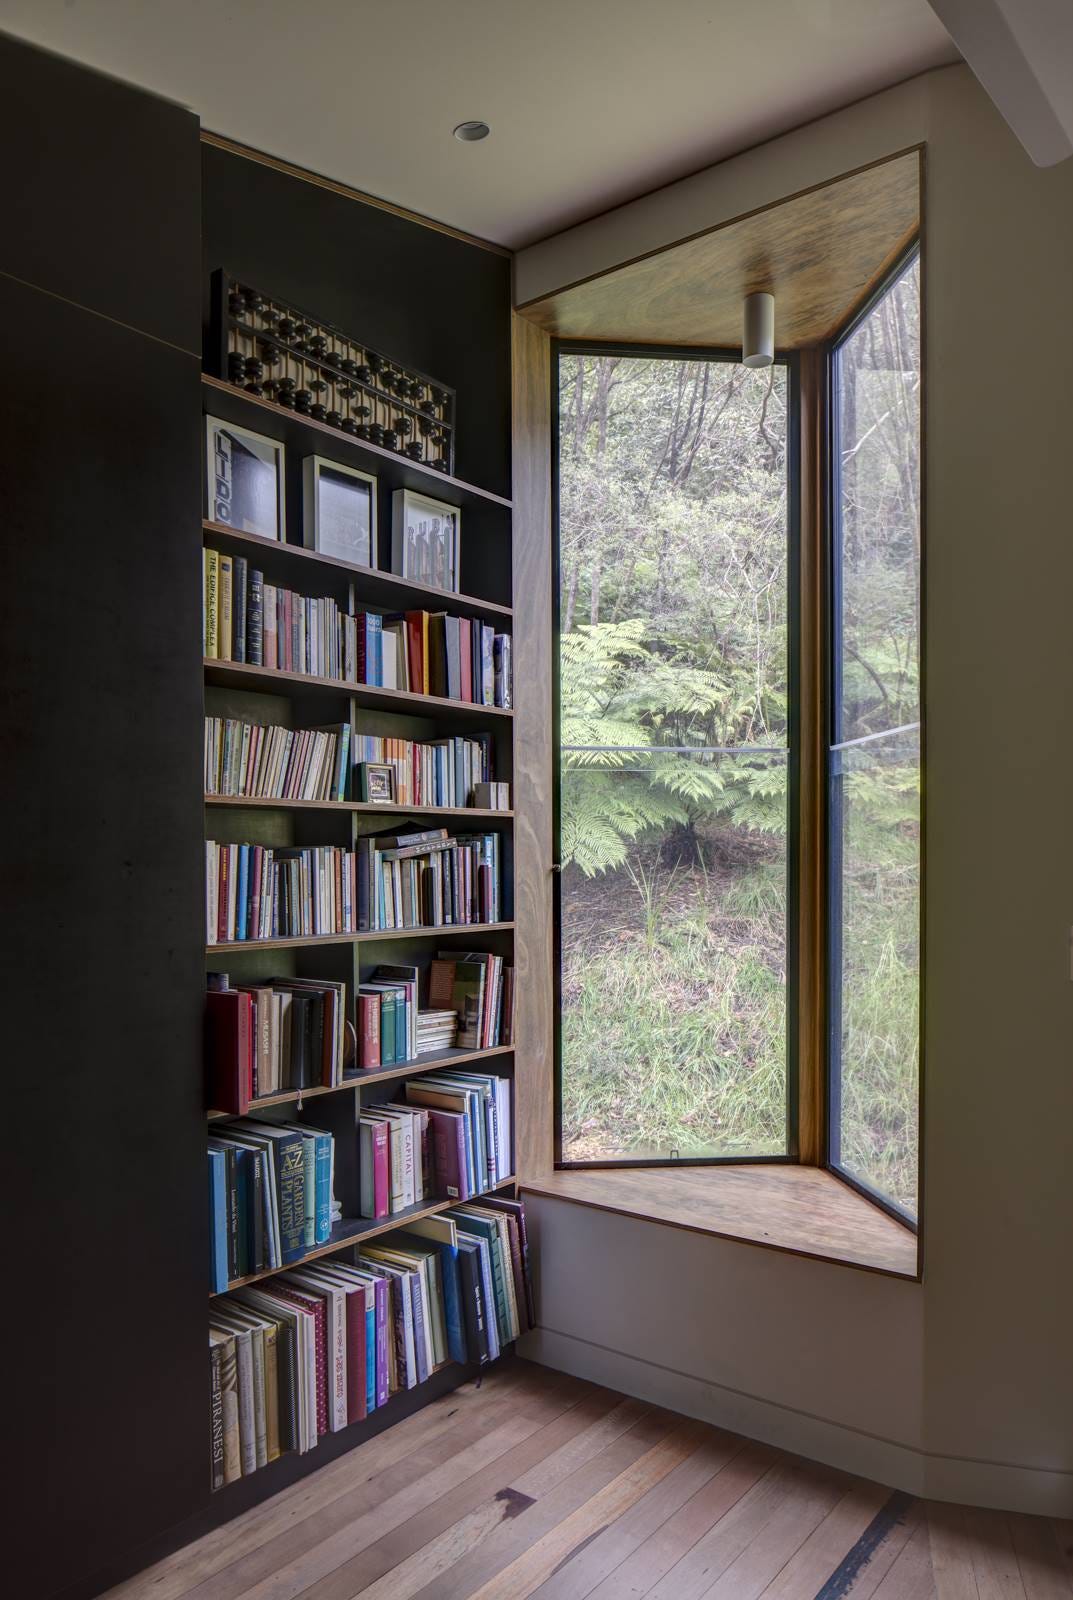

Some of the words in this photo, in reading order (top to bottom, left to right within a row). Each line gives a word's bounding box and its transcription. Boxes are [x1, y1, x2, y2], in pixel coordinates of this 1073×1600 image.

[209, 575, 217, 607] EDIFICE
[262, 1019, 270, 1056] MUSASHI
[282, 1151, 304, 1170] A-Z
[405, 1134, 413, 1176] CAPITAL
[280, 1179, 296, 1232] PLANTS
[293, 1174, 305, 1227] GARDEN
[211, 1392, 223, 1464] PIRANESI
